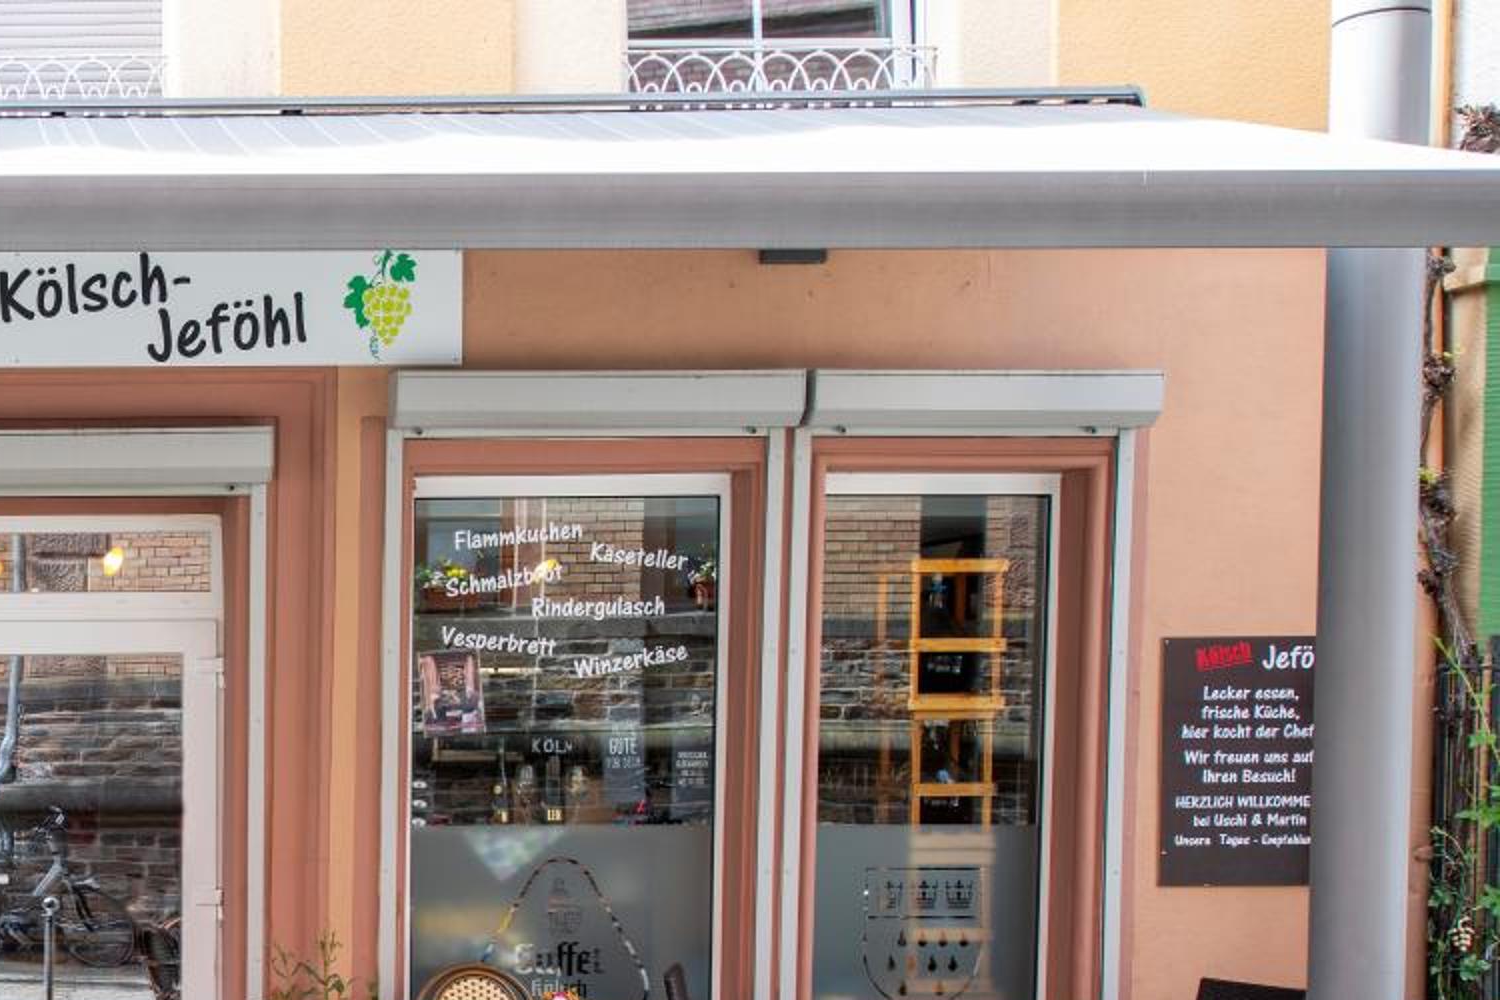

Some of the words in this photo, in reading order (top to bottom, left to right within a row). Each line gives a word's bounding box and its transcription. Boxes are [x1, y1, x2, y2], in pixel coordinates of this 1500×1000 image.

[147, 292, 307, 363] Jeföhl
[455, 523, 583, 551] Flammkuchen
[531, 596, 666, 620] Rindergulasch
[441, 625, 556, 657] Vesperbrett
[574, 644, 688, 680] Winzerkäse
[1262, 645, 1315, 669] Jefö
[1203, 686, 1251, 700] Lecker
[1255, 688, 1299, 701] essen,
[1202, 705, 1249, 719] frische
[1254, 705, 1300, 720] Küche,
[1181, 724, 1209, 738] hier
[1213, 724, 1252, 738] kocht
[1255, 725, 1280, 738] der
[1185, 750, 1209, 764] Wir
[1214, 750, 1259, 764] freuen
[1264, 753, 1288, 763] uns
[1202, 769, 1237, 783] Ihren
[1242, 768, 1296, 783] Besuch!
[1175, 796, 1233, 808] HERZLICH
[1237, 796, 1311, 808] WILLKOMME
[1214, 814, 1247, 826] Uschi
[1251, 815, 1262, 825] &
[1267, 813, 1307, 826] Martin
